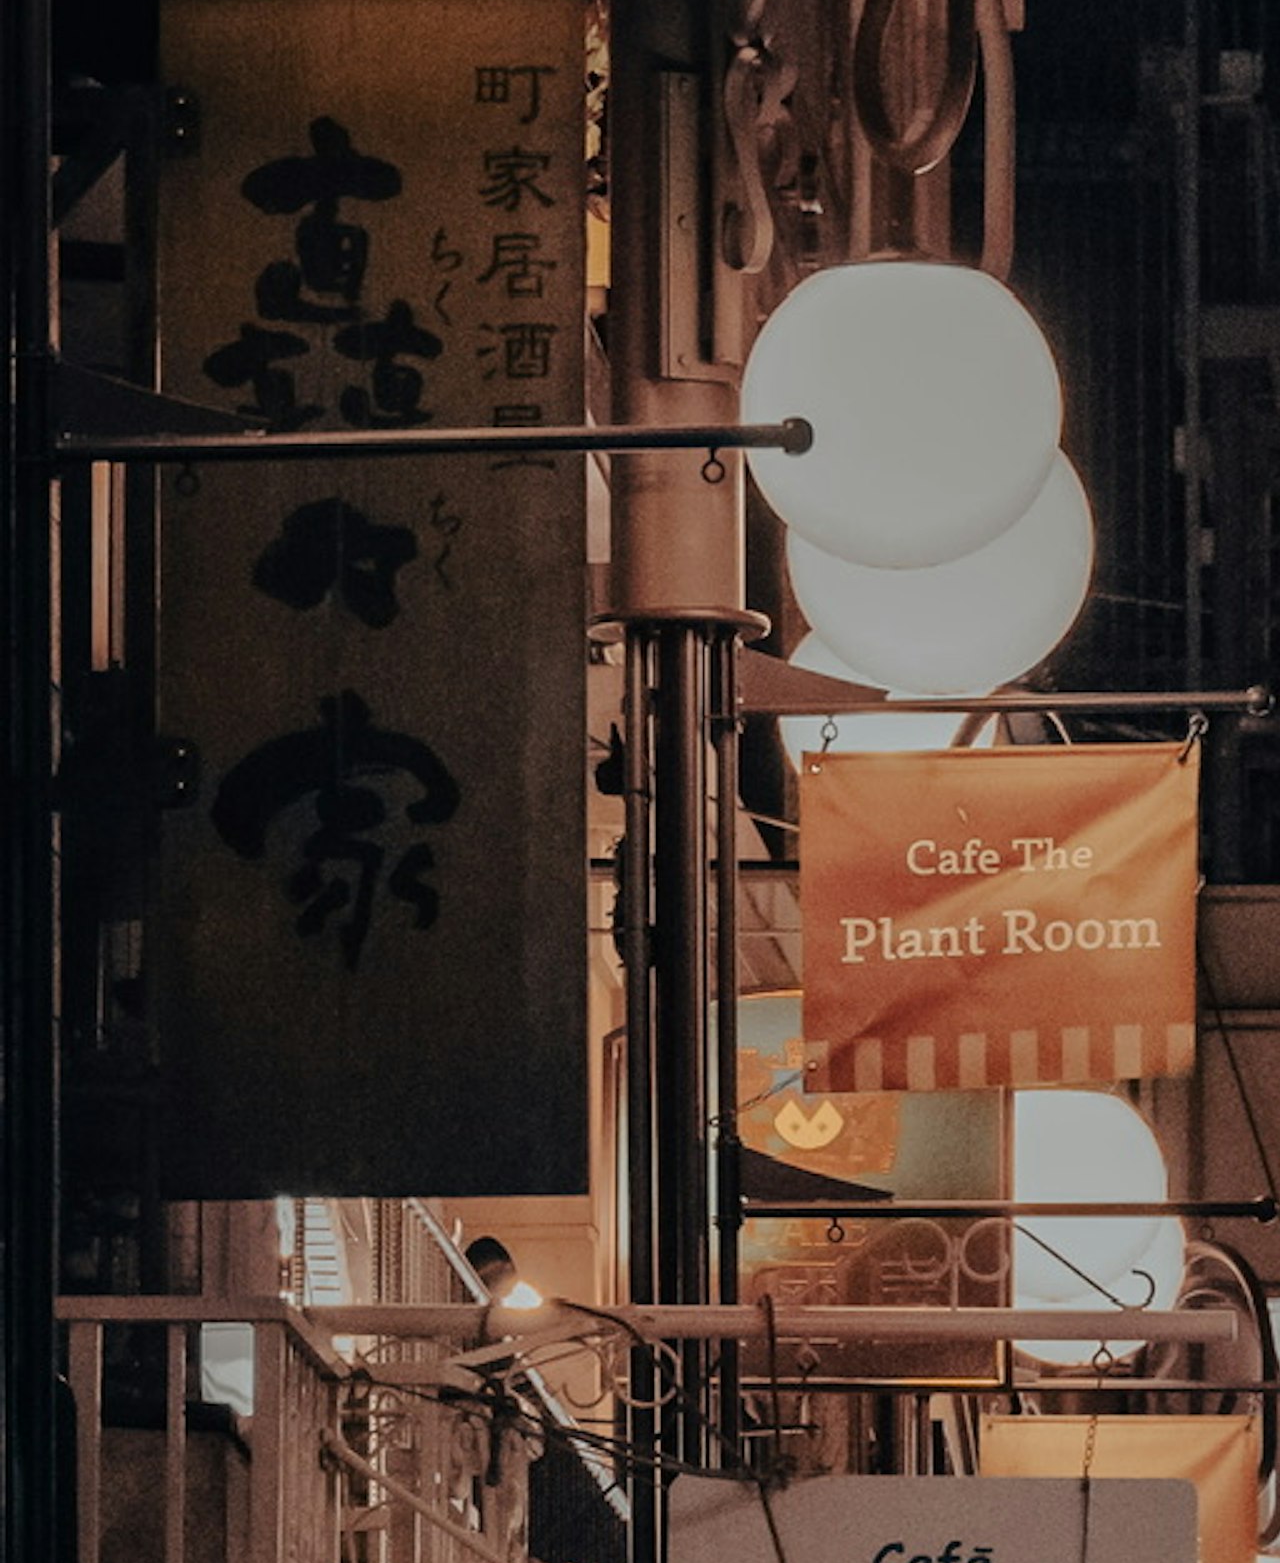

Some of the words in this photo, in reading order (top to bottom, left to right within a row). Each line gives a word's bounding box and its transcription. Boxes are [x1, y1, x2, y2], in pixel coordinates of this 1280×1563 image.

[905, 840, 1000, 875] Cafe
[1012, 837, 1093, 871] The
[839, 916, 986, 964] Plant
[1001, 909, 1162, 956] Room
